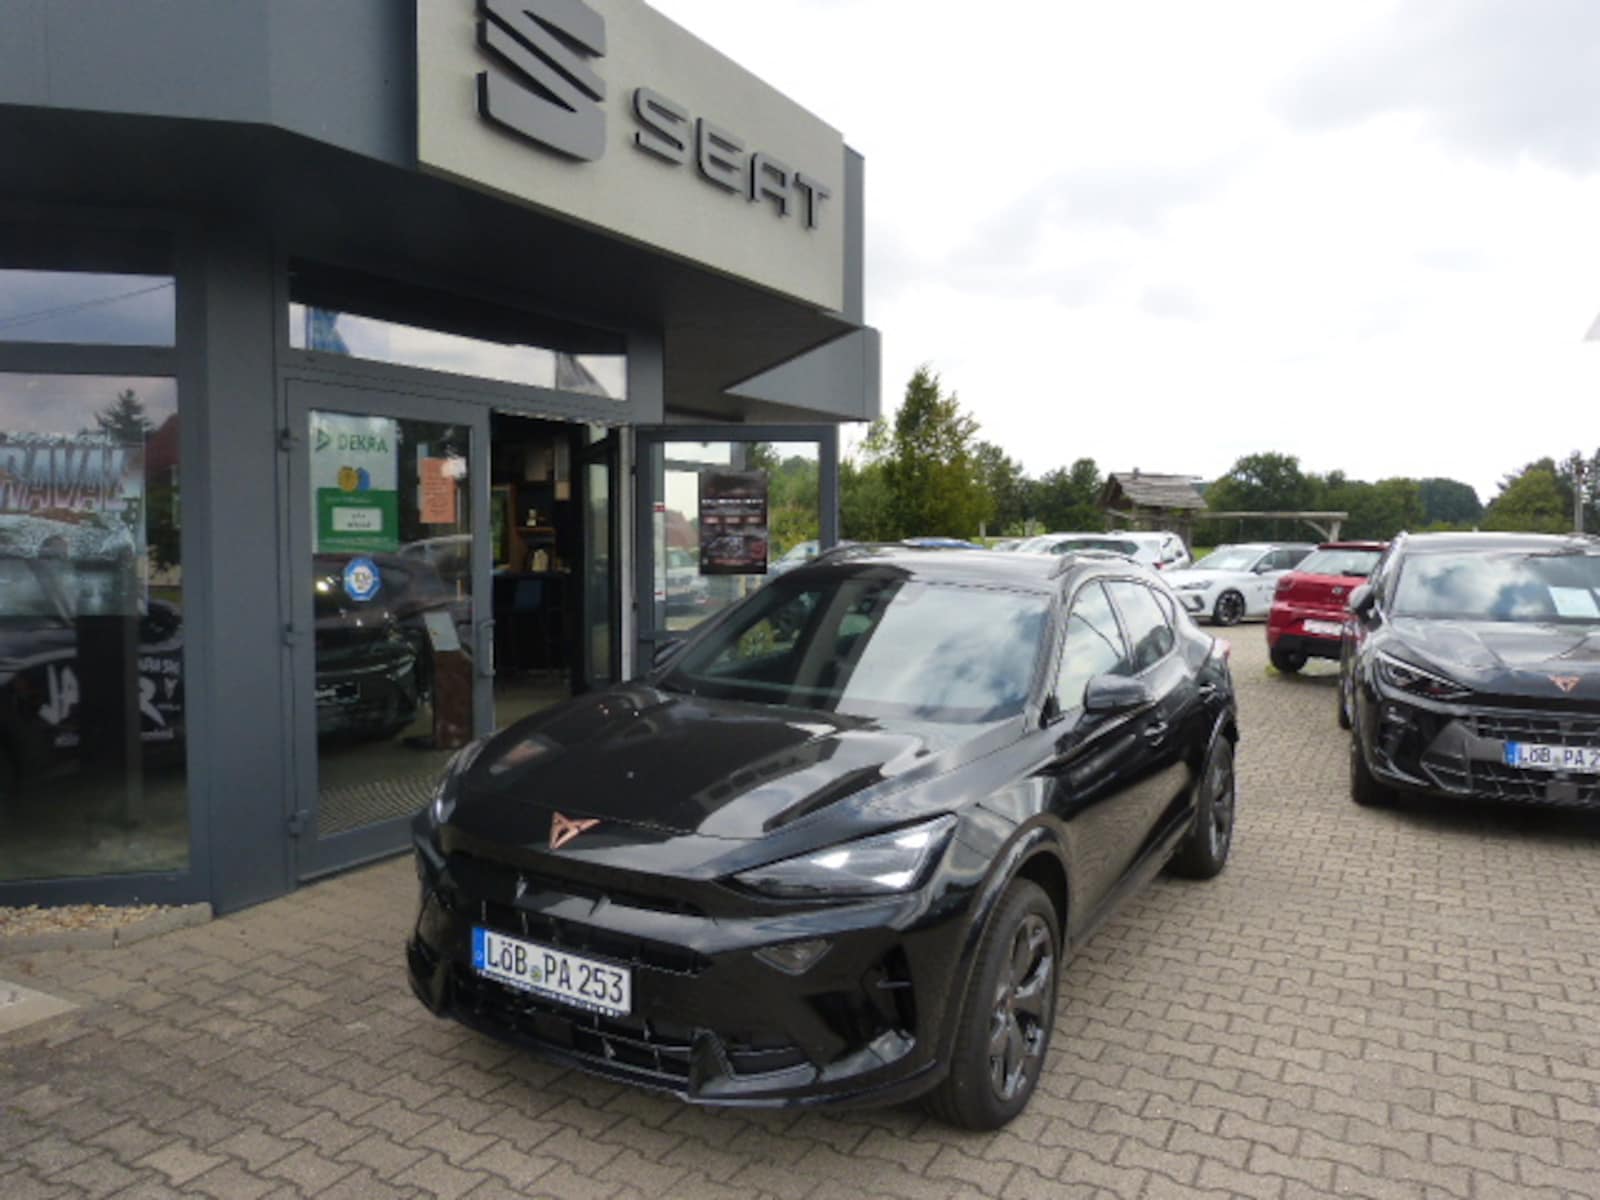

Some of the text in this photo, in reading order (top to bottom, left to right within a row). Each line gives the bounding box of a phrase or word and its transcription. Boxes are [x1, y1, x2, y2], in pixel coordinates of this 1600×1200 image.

[632, 86, 832, 230] SEAT
[337, 432, 389, 453] DEKRA
[1563, 749, 1585, 765] PA
[543, 953, 572, 990] PA
[578, 964, 623, 1004] 253
